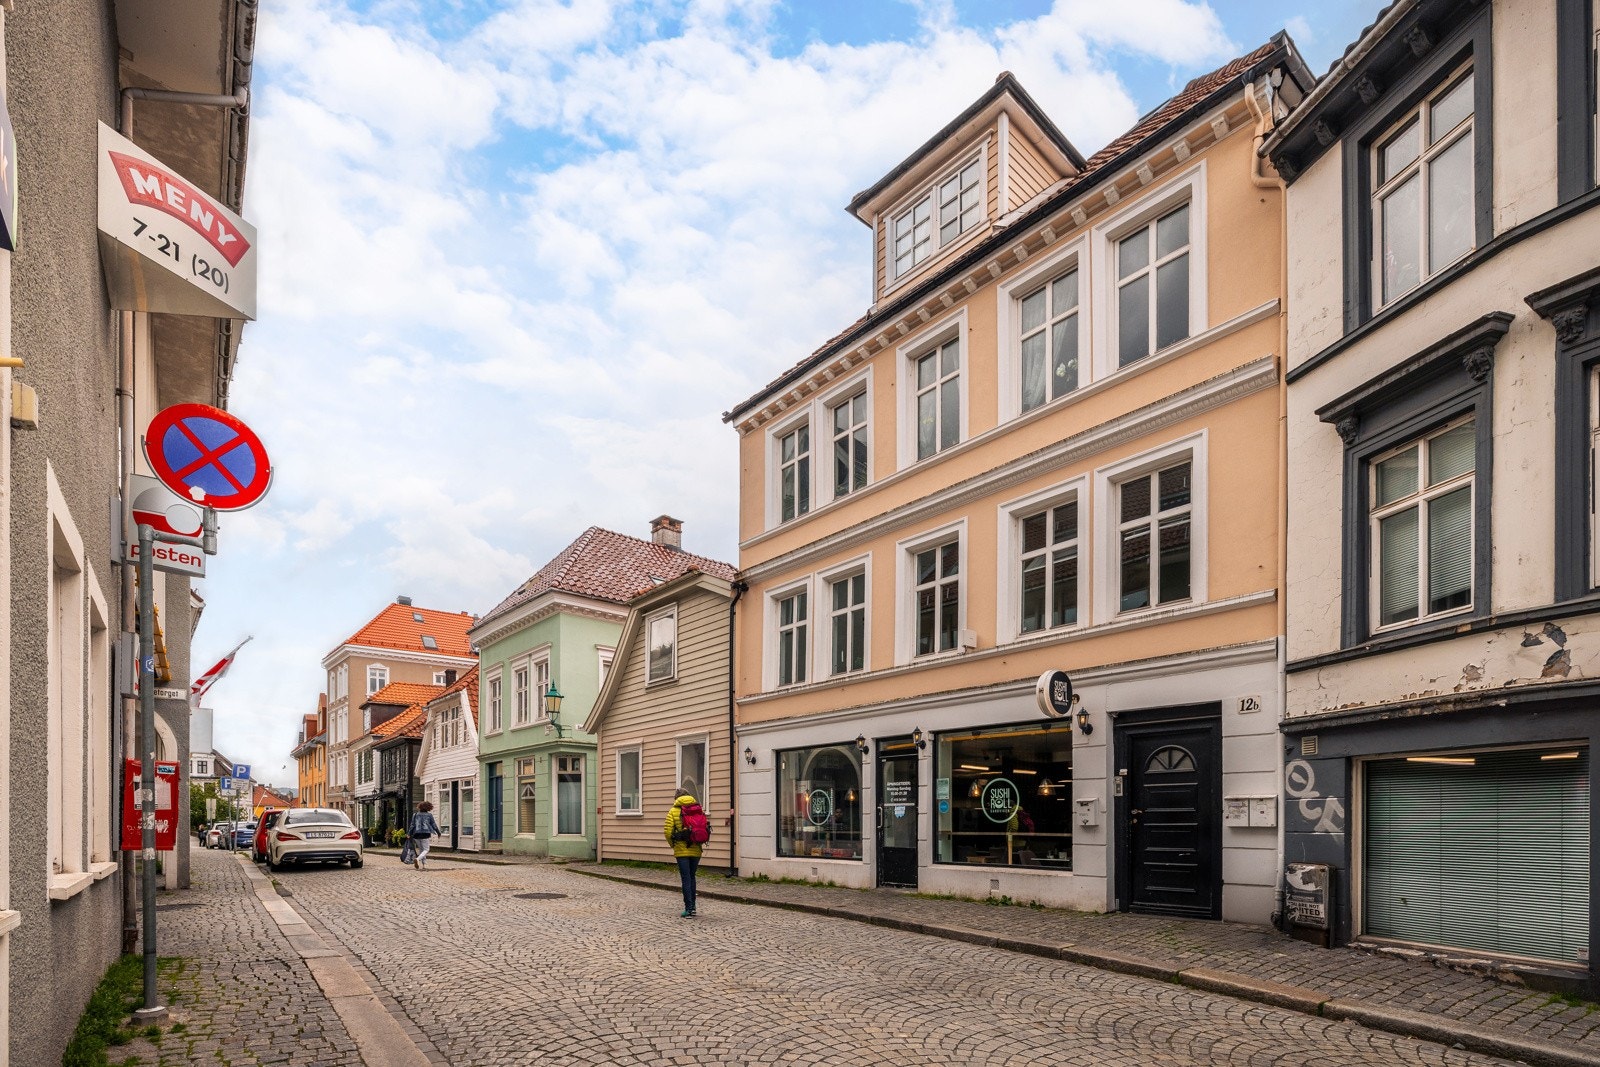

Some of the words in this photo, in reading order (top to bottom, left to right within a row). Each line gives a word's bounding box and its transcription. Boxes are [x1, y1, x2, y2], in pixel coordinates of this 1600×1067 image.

[128, 167, 238, 246] MENY
[132, 216, 180, 262] 7-21
[192, 253, 230, 294] (20)
[130, 543, 202, 567] psten
[1239, 697, 1260, 712] 12b
[236, 765, 247, 777] P
[990, 788, 1010, 798] SUSHI
[990, 798, 1012, 809] ROLL
